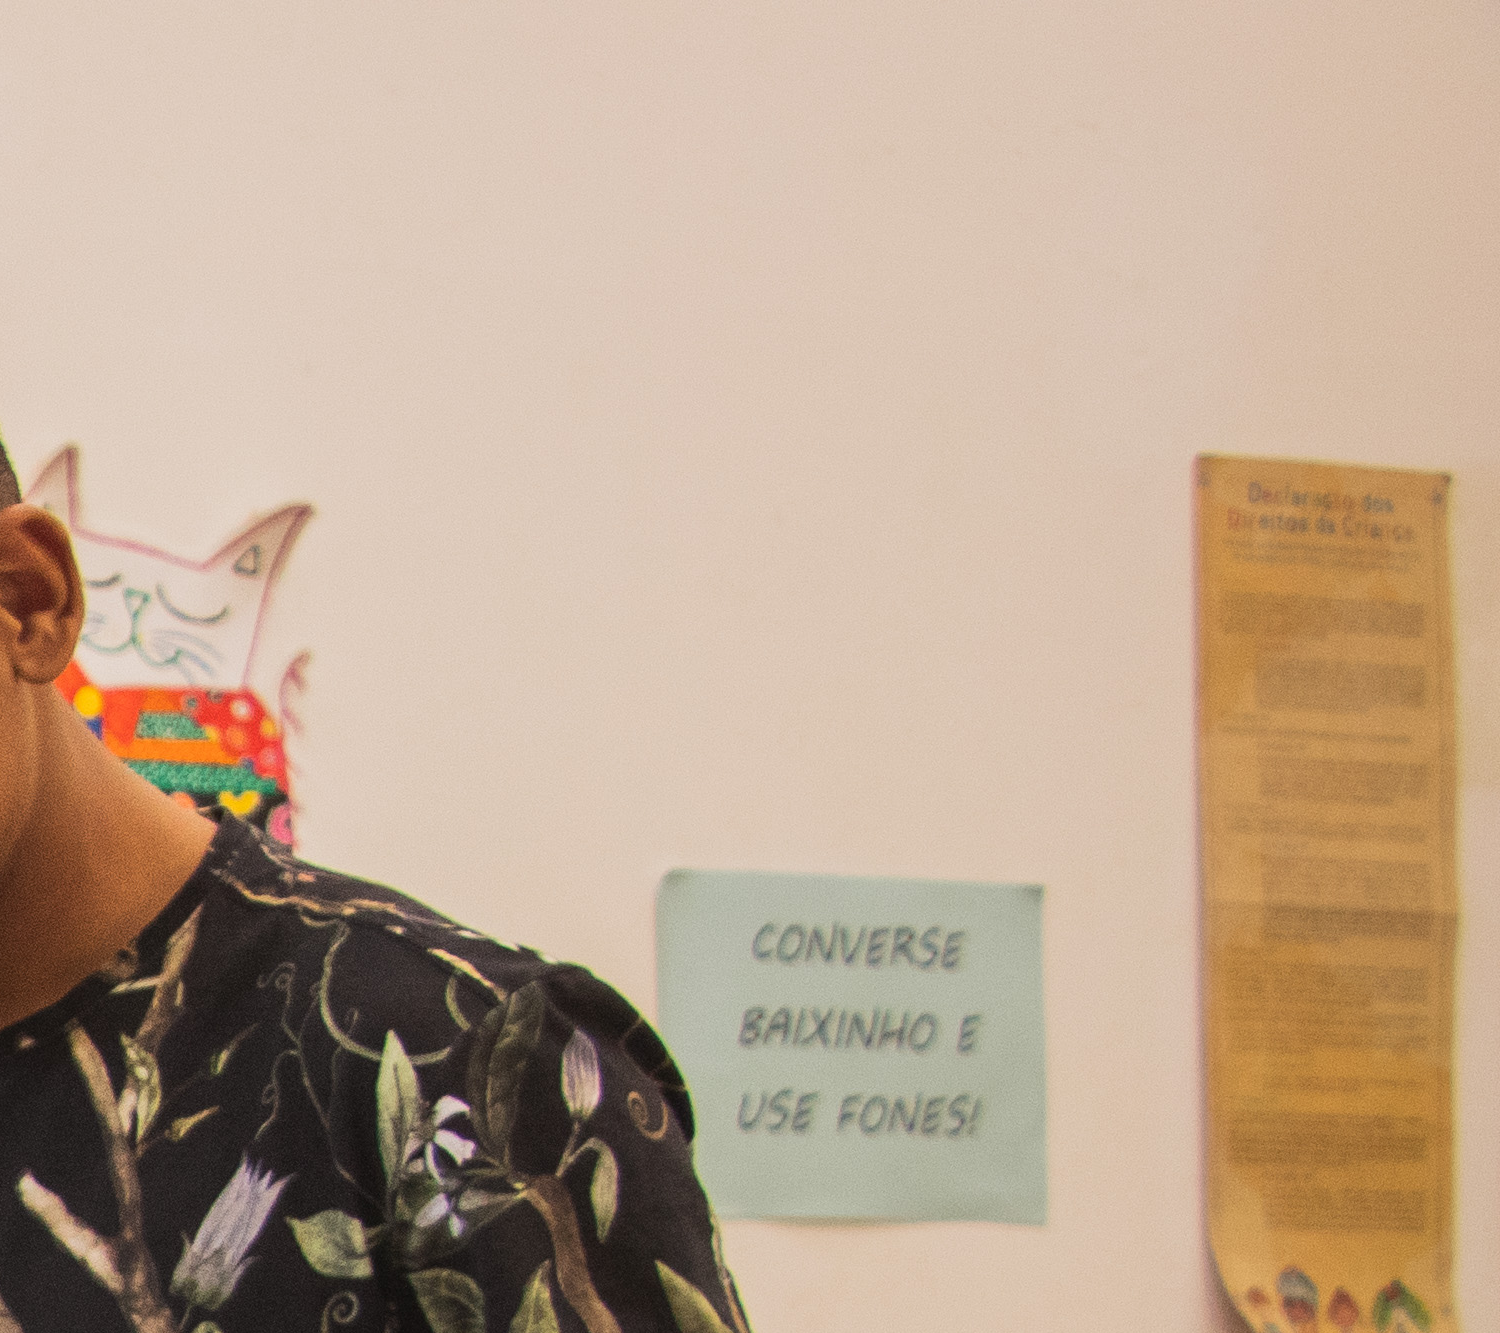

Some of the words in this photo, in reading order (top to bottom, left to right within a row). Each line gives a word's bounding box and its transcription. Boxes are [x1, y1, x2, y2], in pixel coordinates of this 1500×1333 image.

[750, 920, 967, 971] CONVERSE
[736, 1004, 939, 1054] BAIXINHO
[955, 1012, 982, 1055] E
[736, 1087, 820, 1136] USE
[835, 1091, 985, 1139] FONES!
